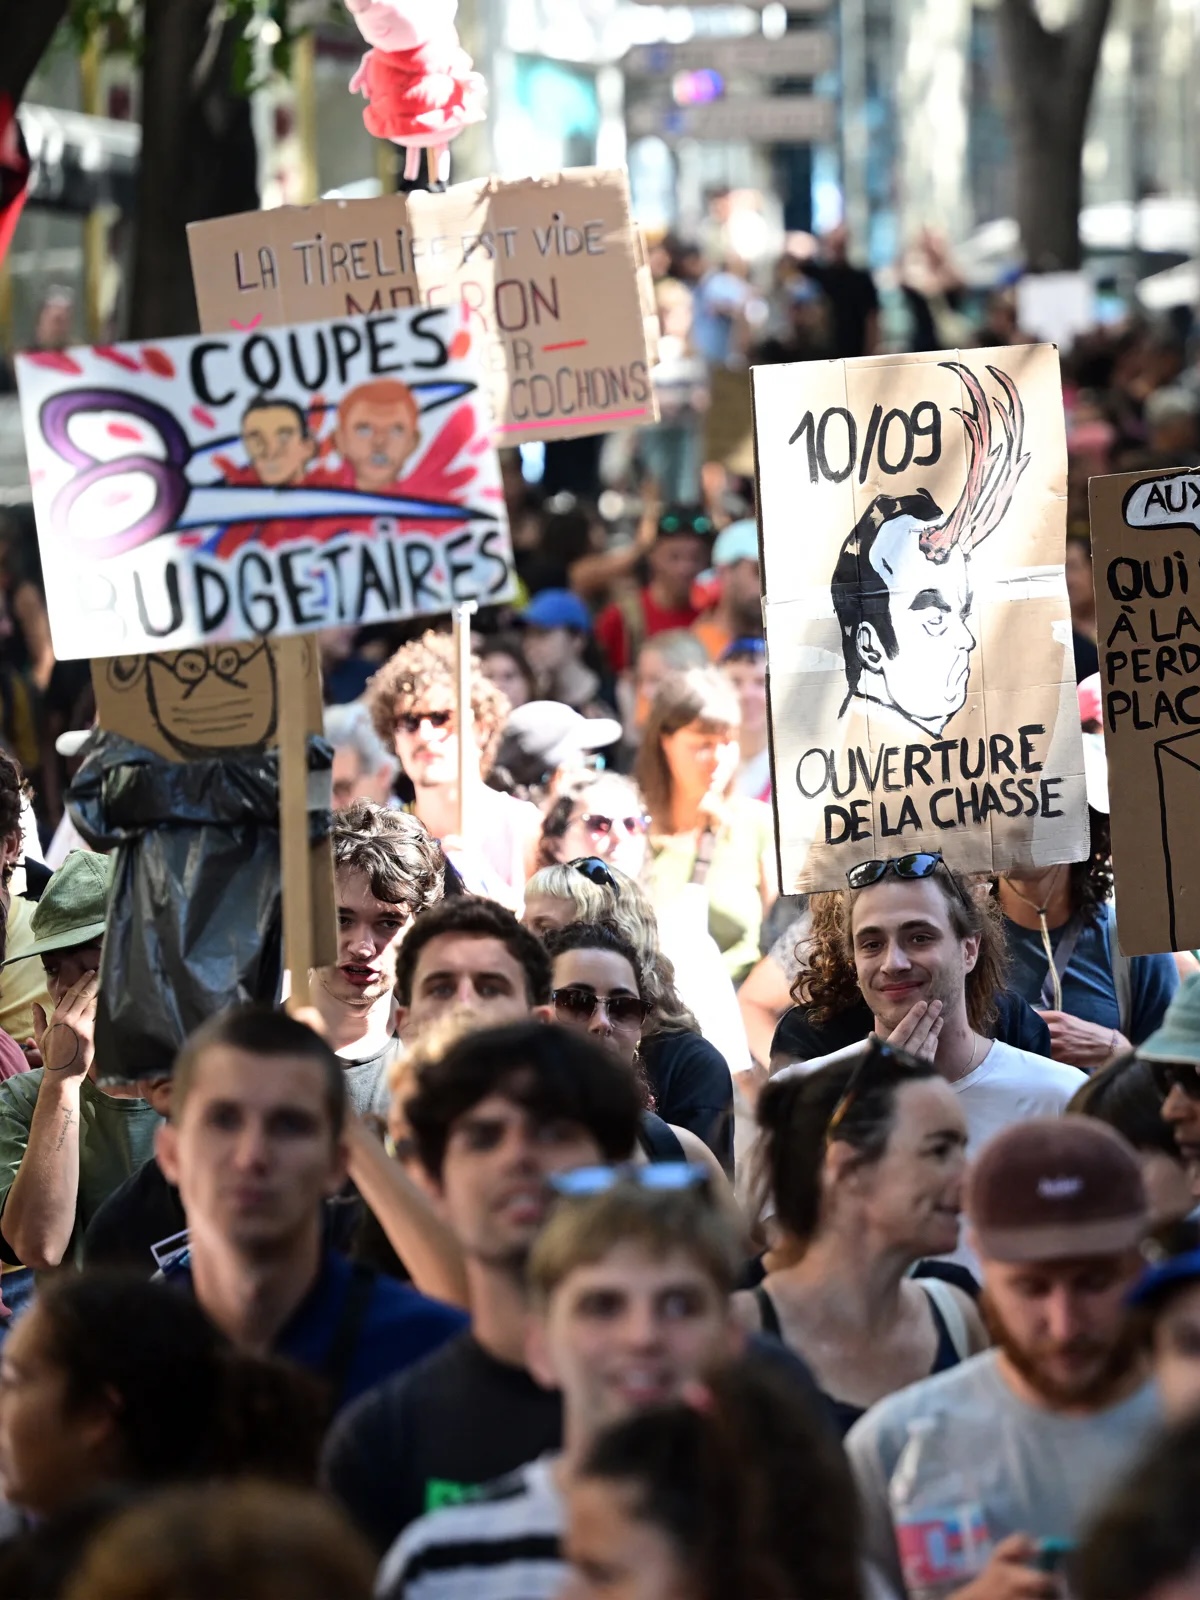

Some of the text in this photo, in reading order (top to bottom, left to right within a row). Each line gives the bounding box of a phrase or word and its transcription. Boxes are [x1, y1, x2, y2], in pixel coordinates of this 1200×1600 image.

[234, 244, 279, 292] LA
[532, 212, 604, 258] ViDE
[189, 308, 449, 406] COUPES
[511, 361, 650, 421] COCHONS
[788, 400, 942, 484] 10/09
[1106, 551, 1189, 602] QUi
[1106, 606, 1138, 648] À
[795, 723, 1046, 799] OUVERTURE
[824, 777, 1065, 845] DE LA CHASSE
